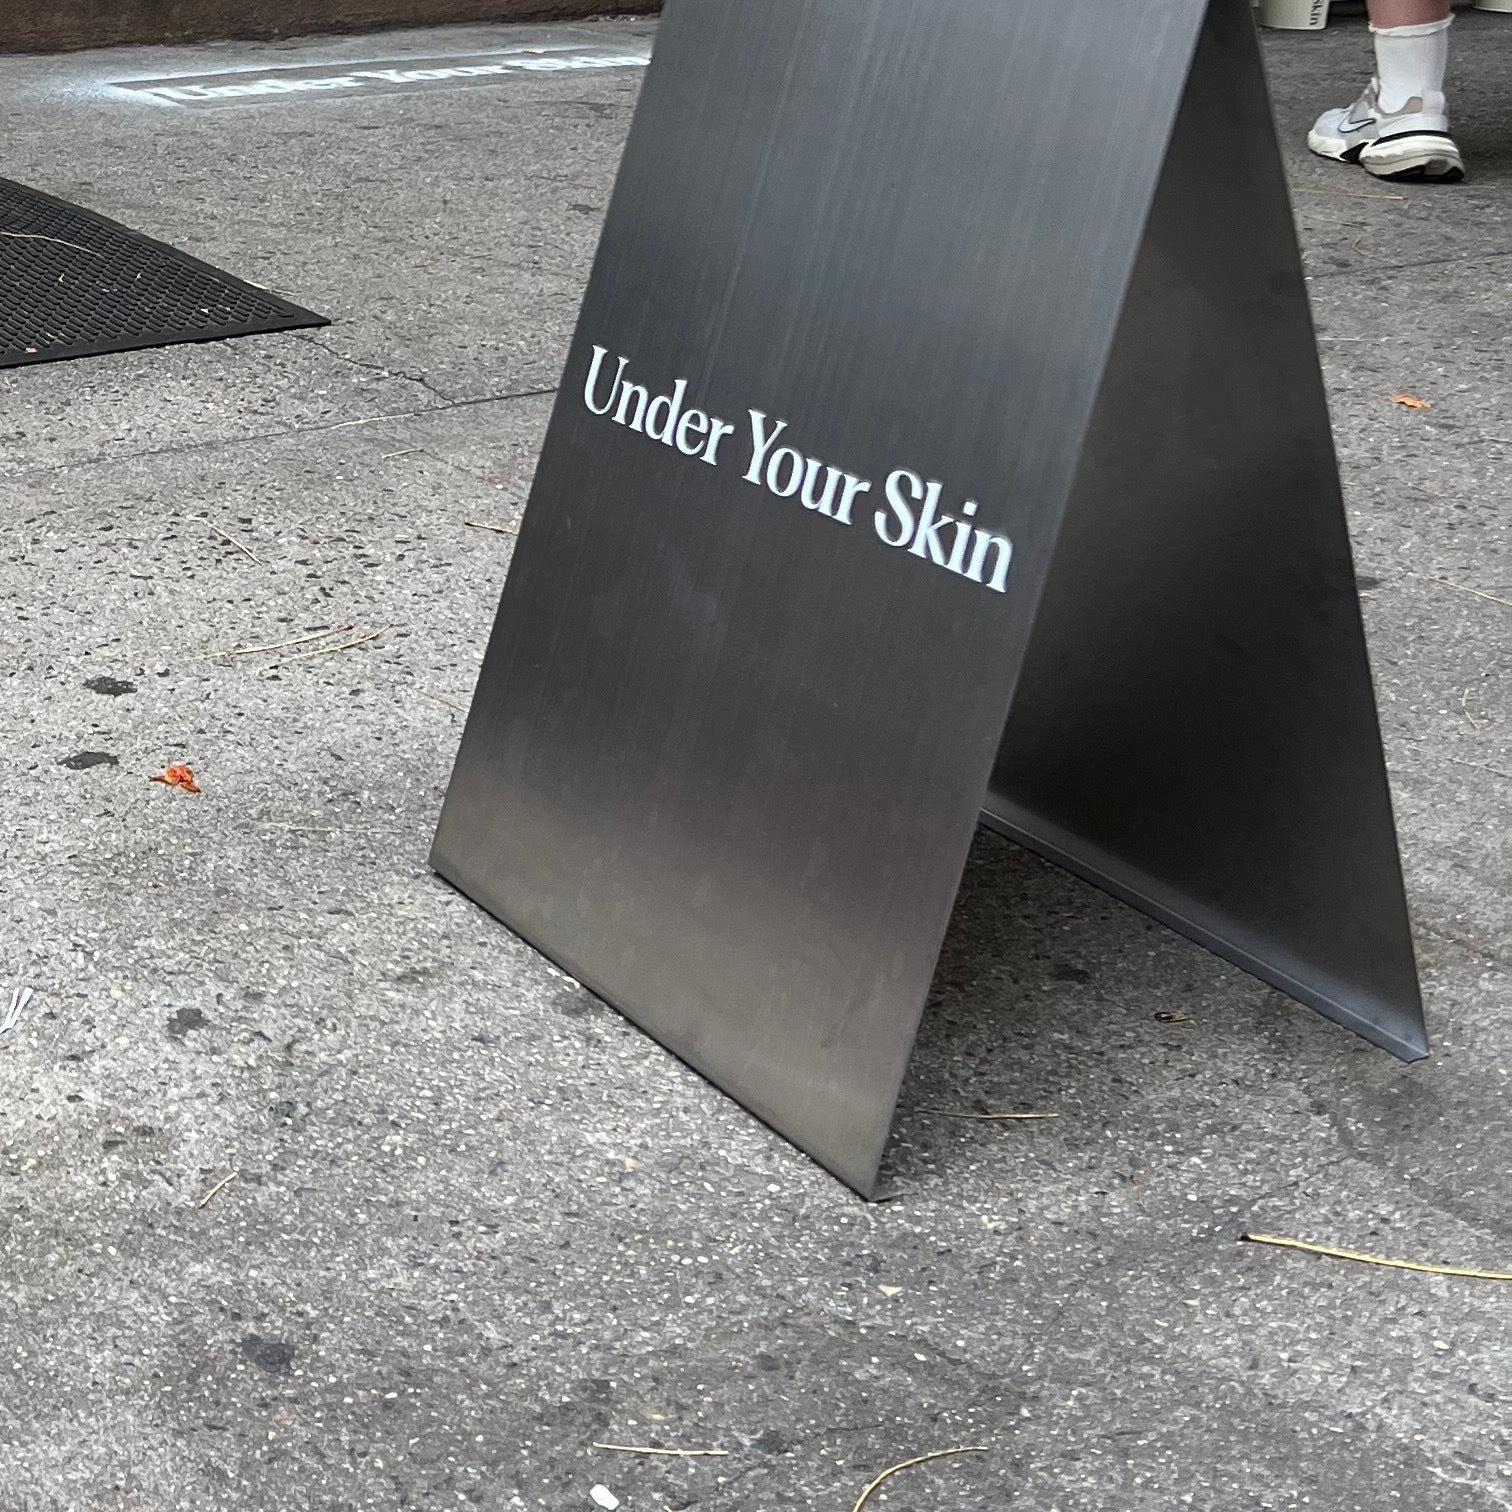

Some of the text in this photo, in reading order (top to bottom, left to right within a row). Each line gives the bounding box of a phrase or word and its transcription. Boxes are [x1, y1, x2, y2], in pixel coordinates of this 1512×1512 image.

[136, 76, 364, 100] Under
[348, 64, 512, 83] Your
[583, 344, 1015, 594] Under Your Skin
